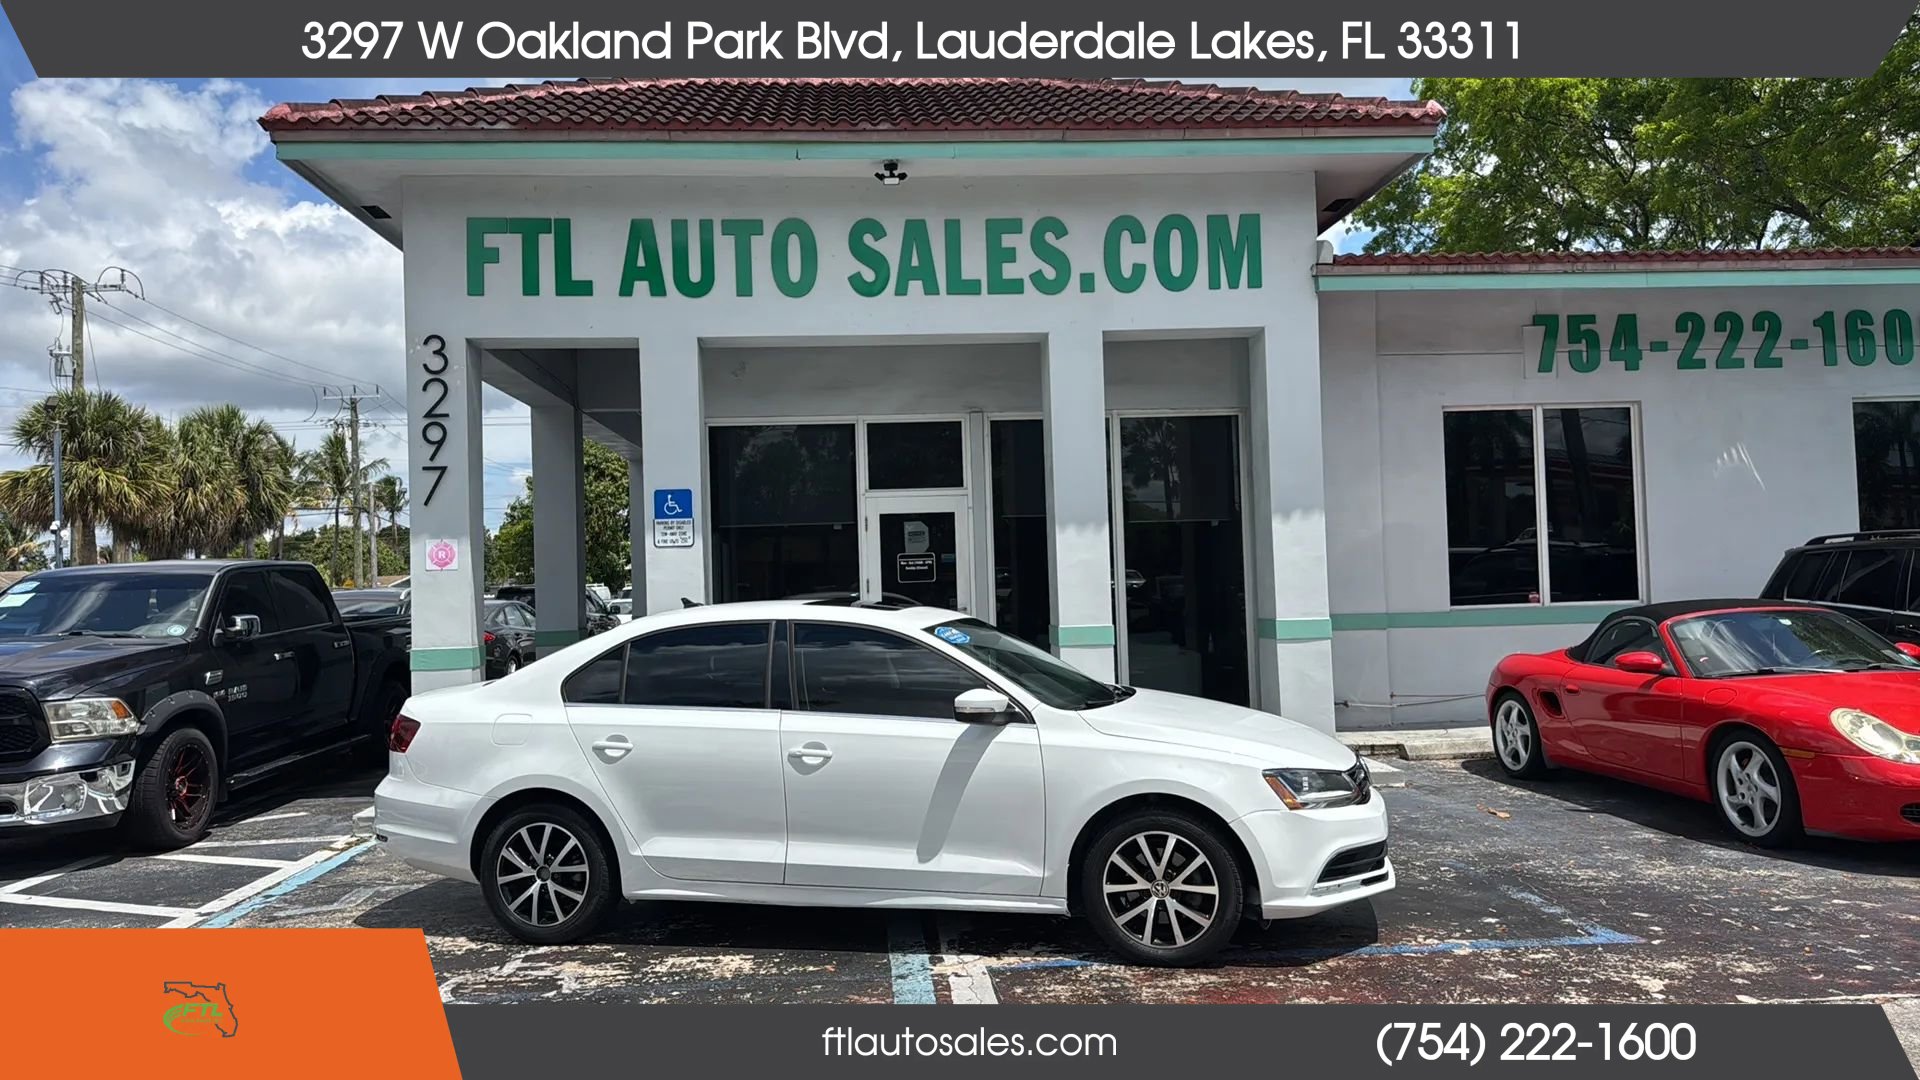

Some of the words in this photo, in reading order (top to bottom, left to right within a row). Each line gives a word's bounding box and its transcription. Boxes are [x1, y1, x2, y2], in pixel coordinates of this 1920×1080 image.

[466, 218, 594, 297] FTL
[619, 218, 818, 299] AUTO
[848, 213, 1263, 297] SALES.COM
[421, 334, 450, 507] 3297
